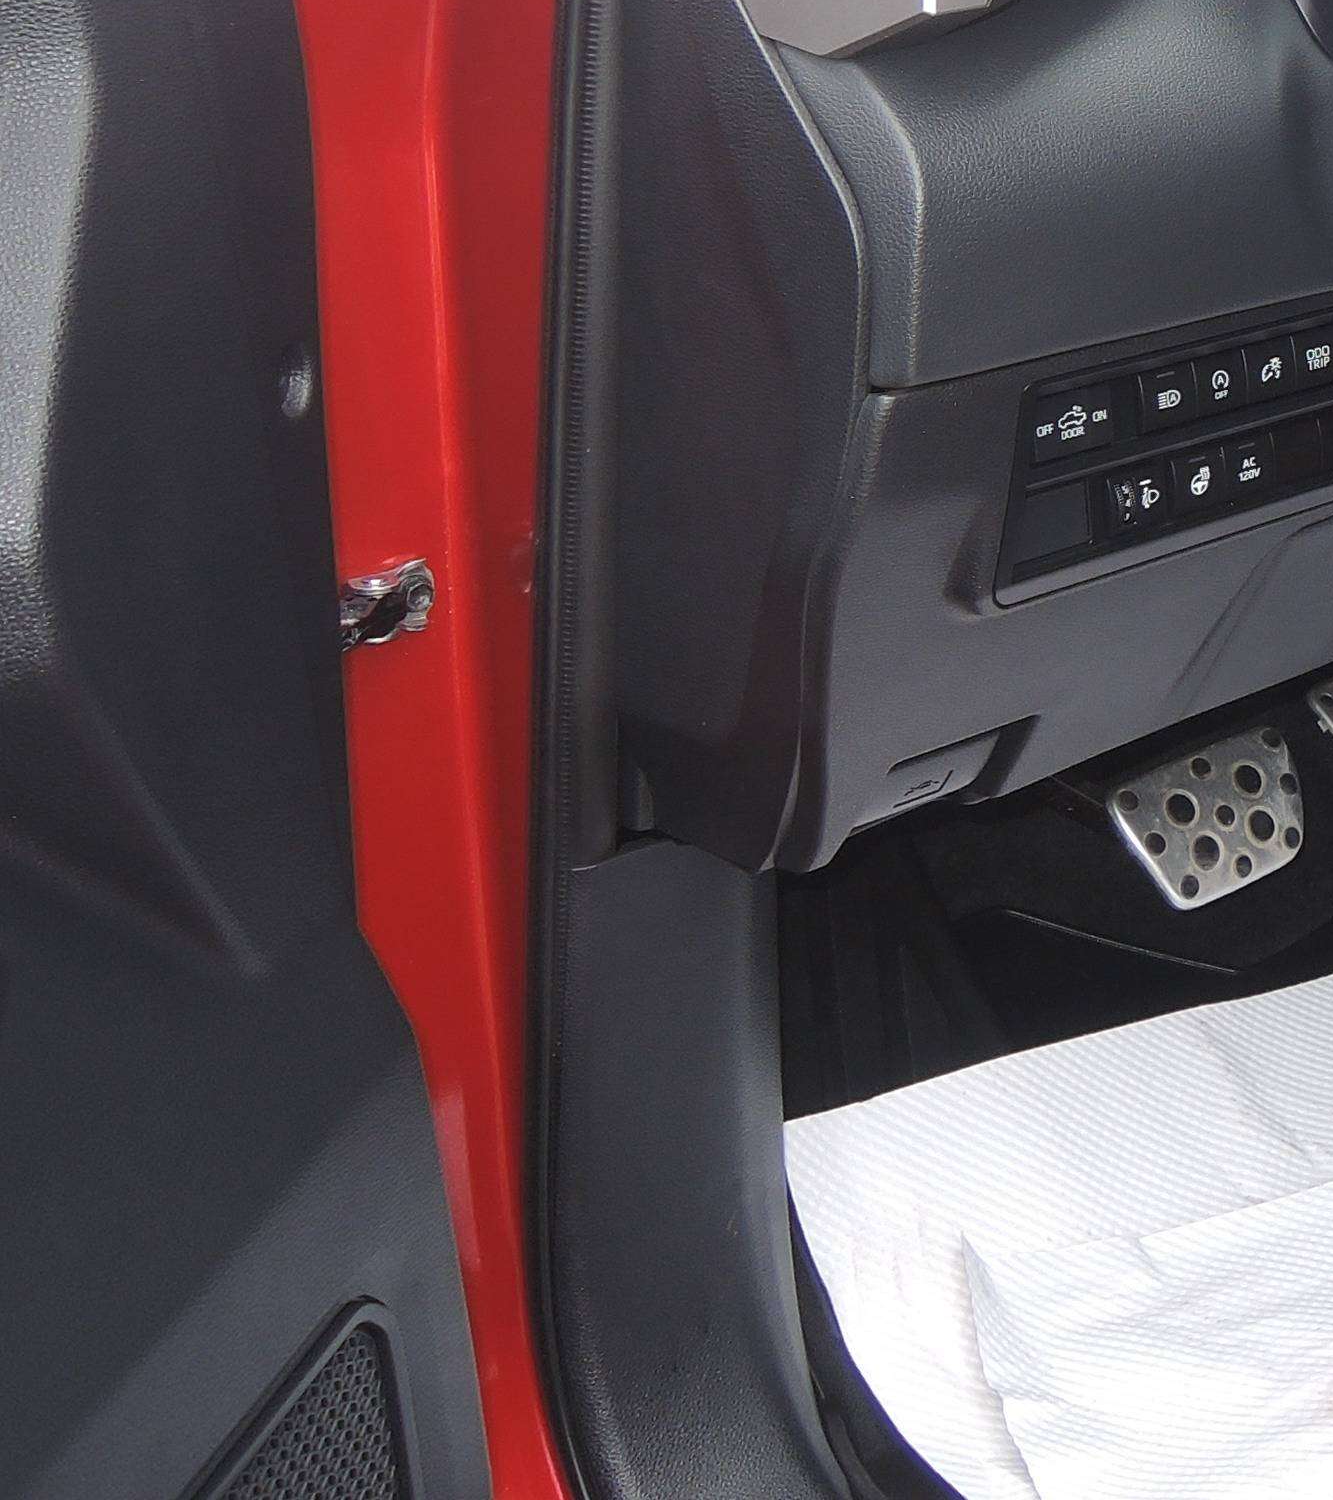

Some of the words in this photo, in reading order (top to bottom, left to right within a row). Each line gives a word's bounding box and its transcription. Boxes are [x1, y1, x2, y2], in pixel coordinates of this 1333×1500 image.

[1305, 344, 1330, 361] ODO
[1306, 356, 1330, 371] TRIP
[1214, 389, 1229, 400] OFF
[1035, 422, 1055, 438] OFF
[1092, 408, 1108, 423] ON
[1060, 425, 1086, 441] DOOR
[1242, 456, 1257, 470] AC
[1237, 467, 1261, 482] 120V
